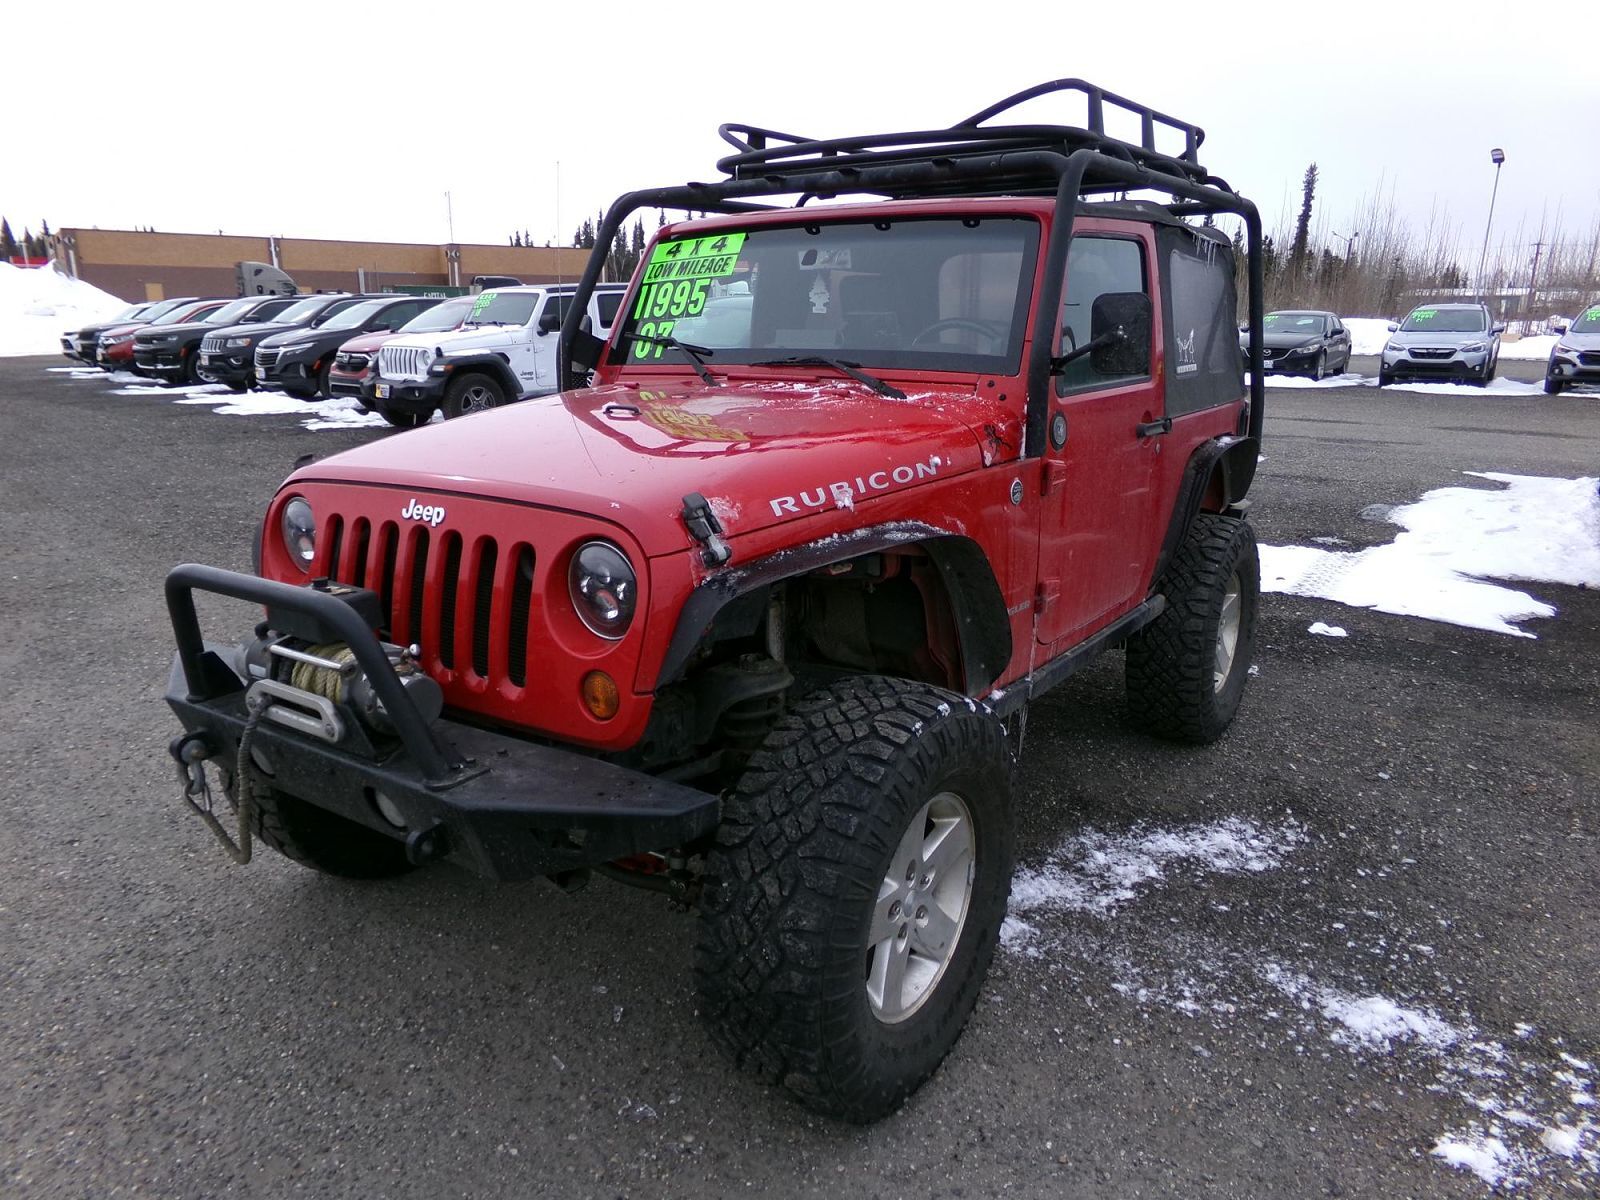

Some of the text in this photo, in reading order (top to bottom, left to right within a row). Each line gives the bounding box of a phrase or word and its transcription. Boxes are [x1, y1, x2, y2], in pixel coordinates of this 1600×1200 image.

[666, 236, 729, 258] 4 X 4
[647, 256, 732, 280] LOW MILEAGE
[633, 278, 711, 320] 11995
[635, 321, 675, 359] 07
[769, 460, 939, 517] RUBICON
[401, 498, 446, 528] Jeep
